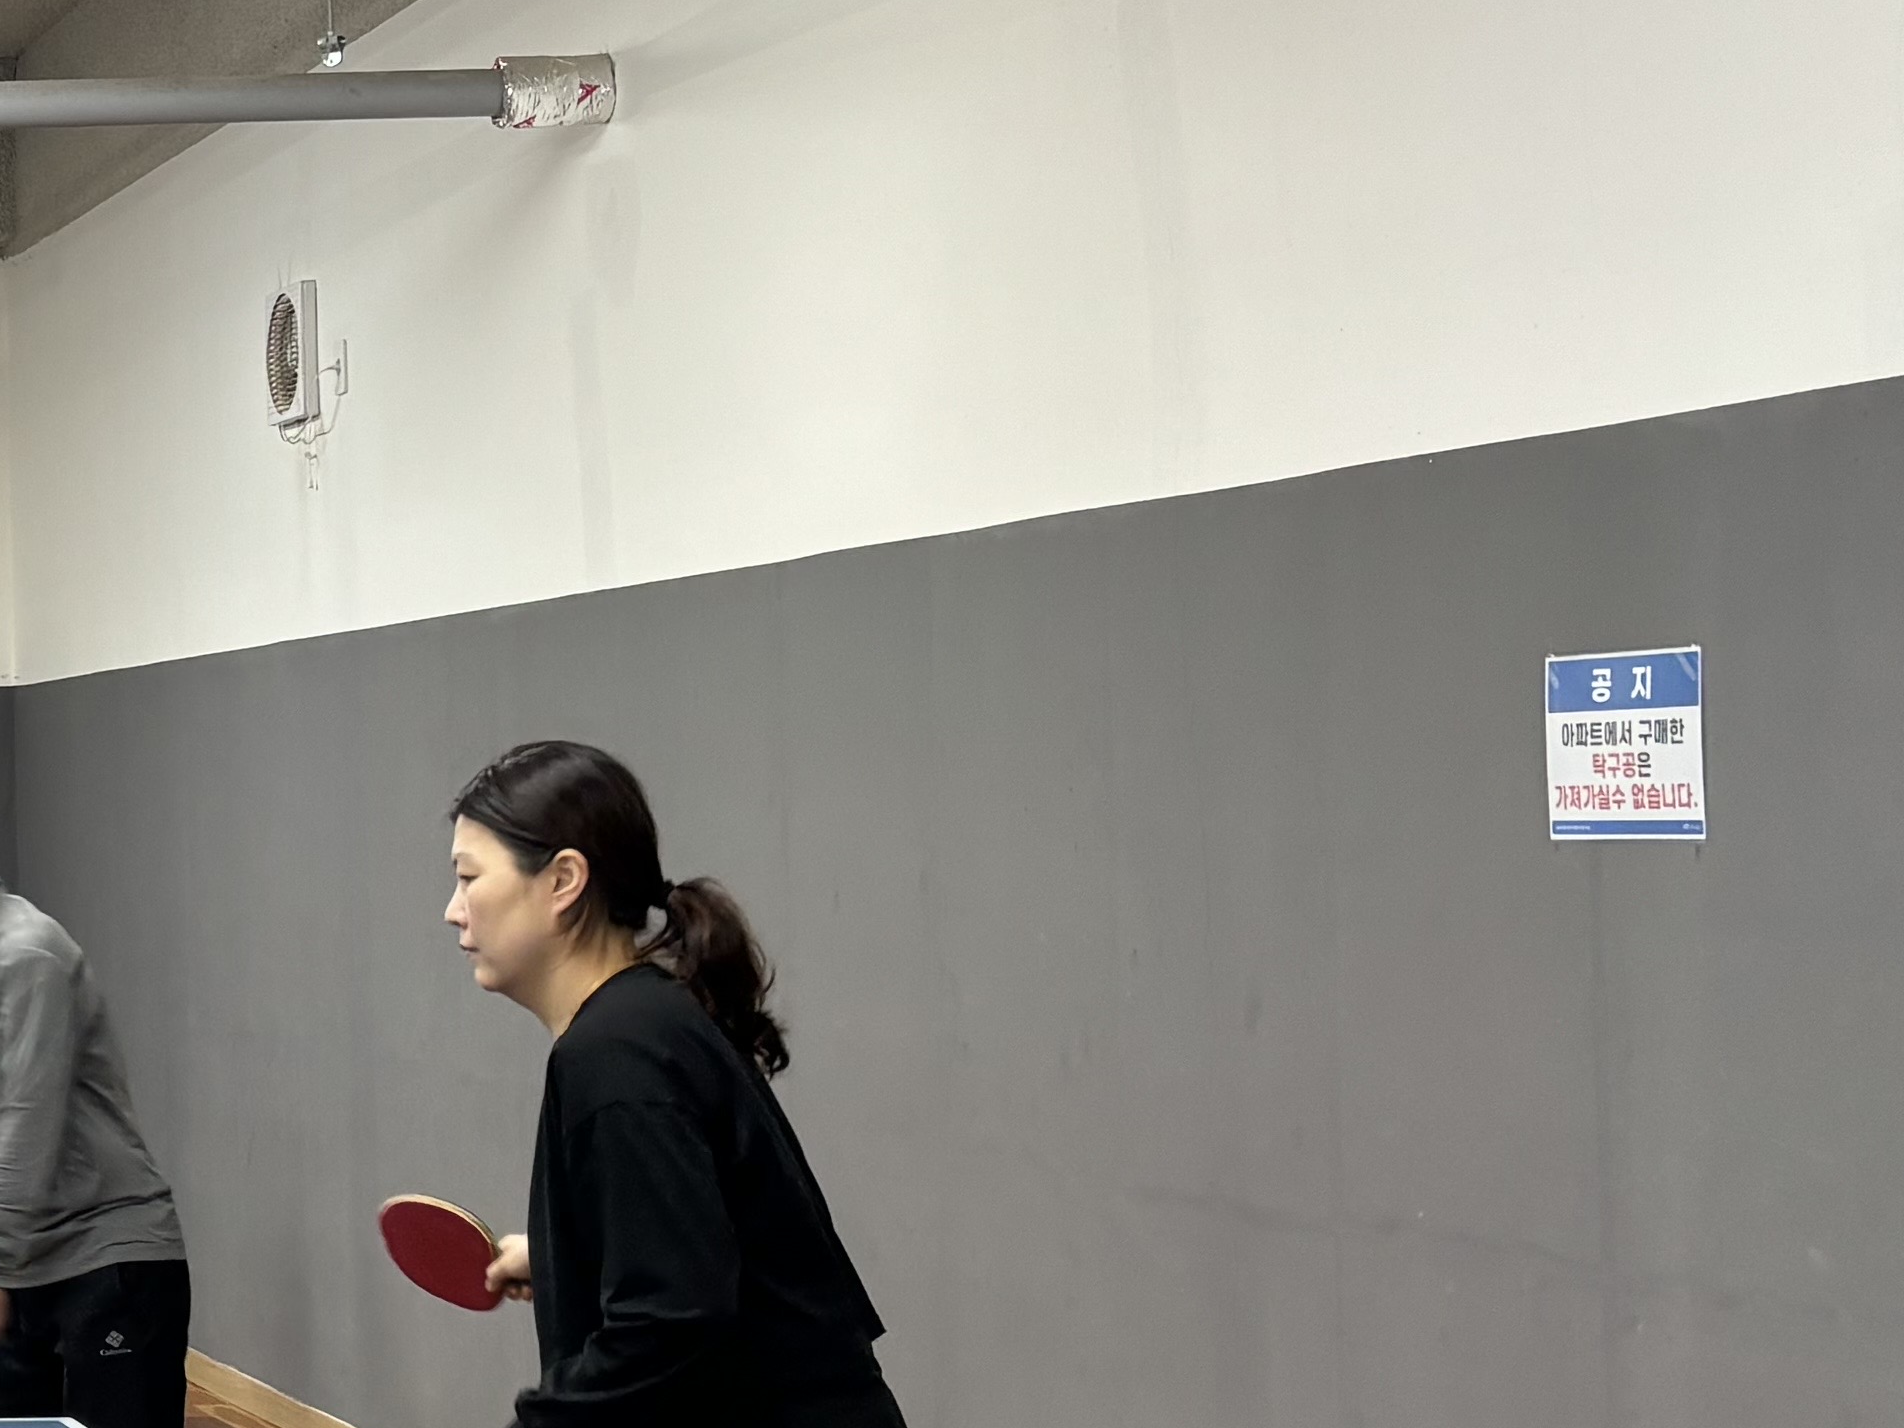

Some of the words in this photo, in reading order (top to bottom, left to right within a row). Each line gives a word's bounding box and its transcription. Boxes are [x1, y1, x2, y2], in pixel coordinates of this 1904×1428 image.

[1561, 720, 1633, 748] 아파트에서
[1638, 717, 1685, 746] 구매한
[1592, 751, 1651, 779] 탁구공은
[1631, 783, 1699, 810] 없습니다.
